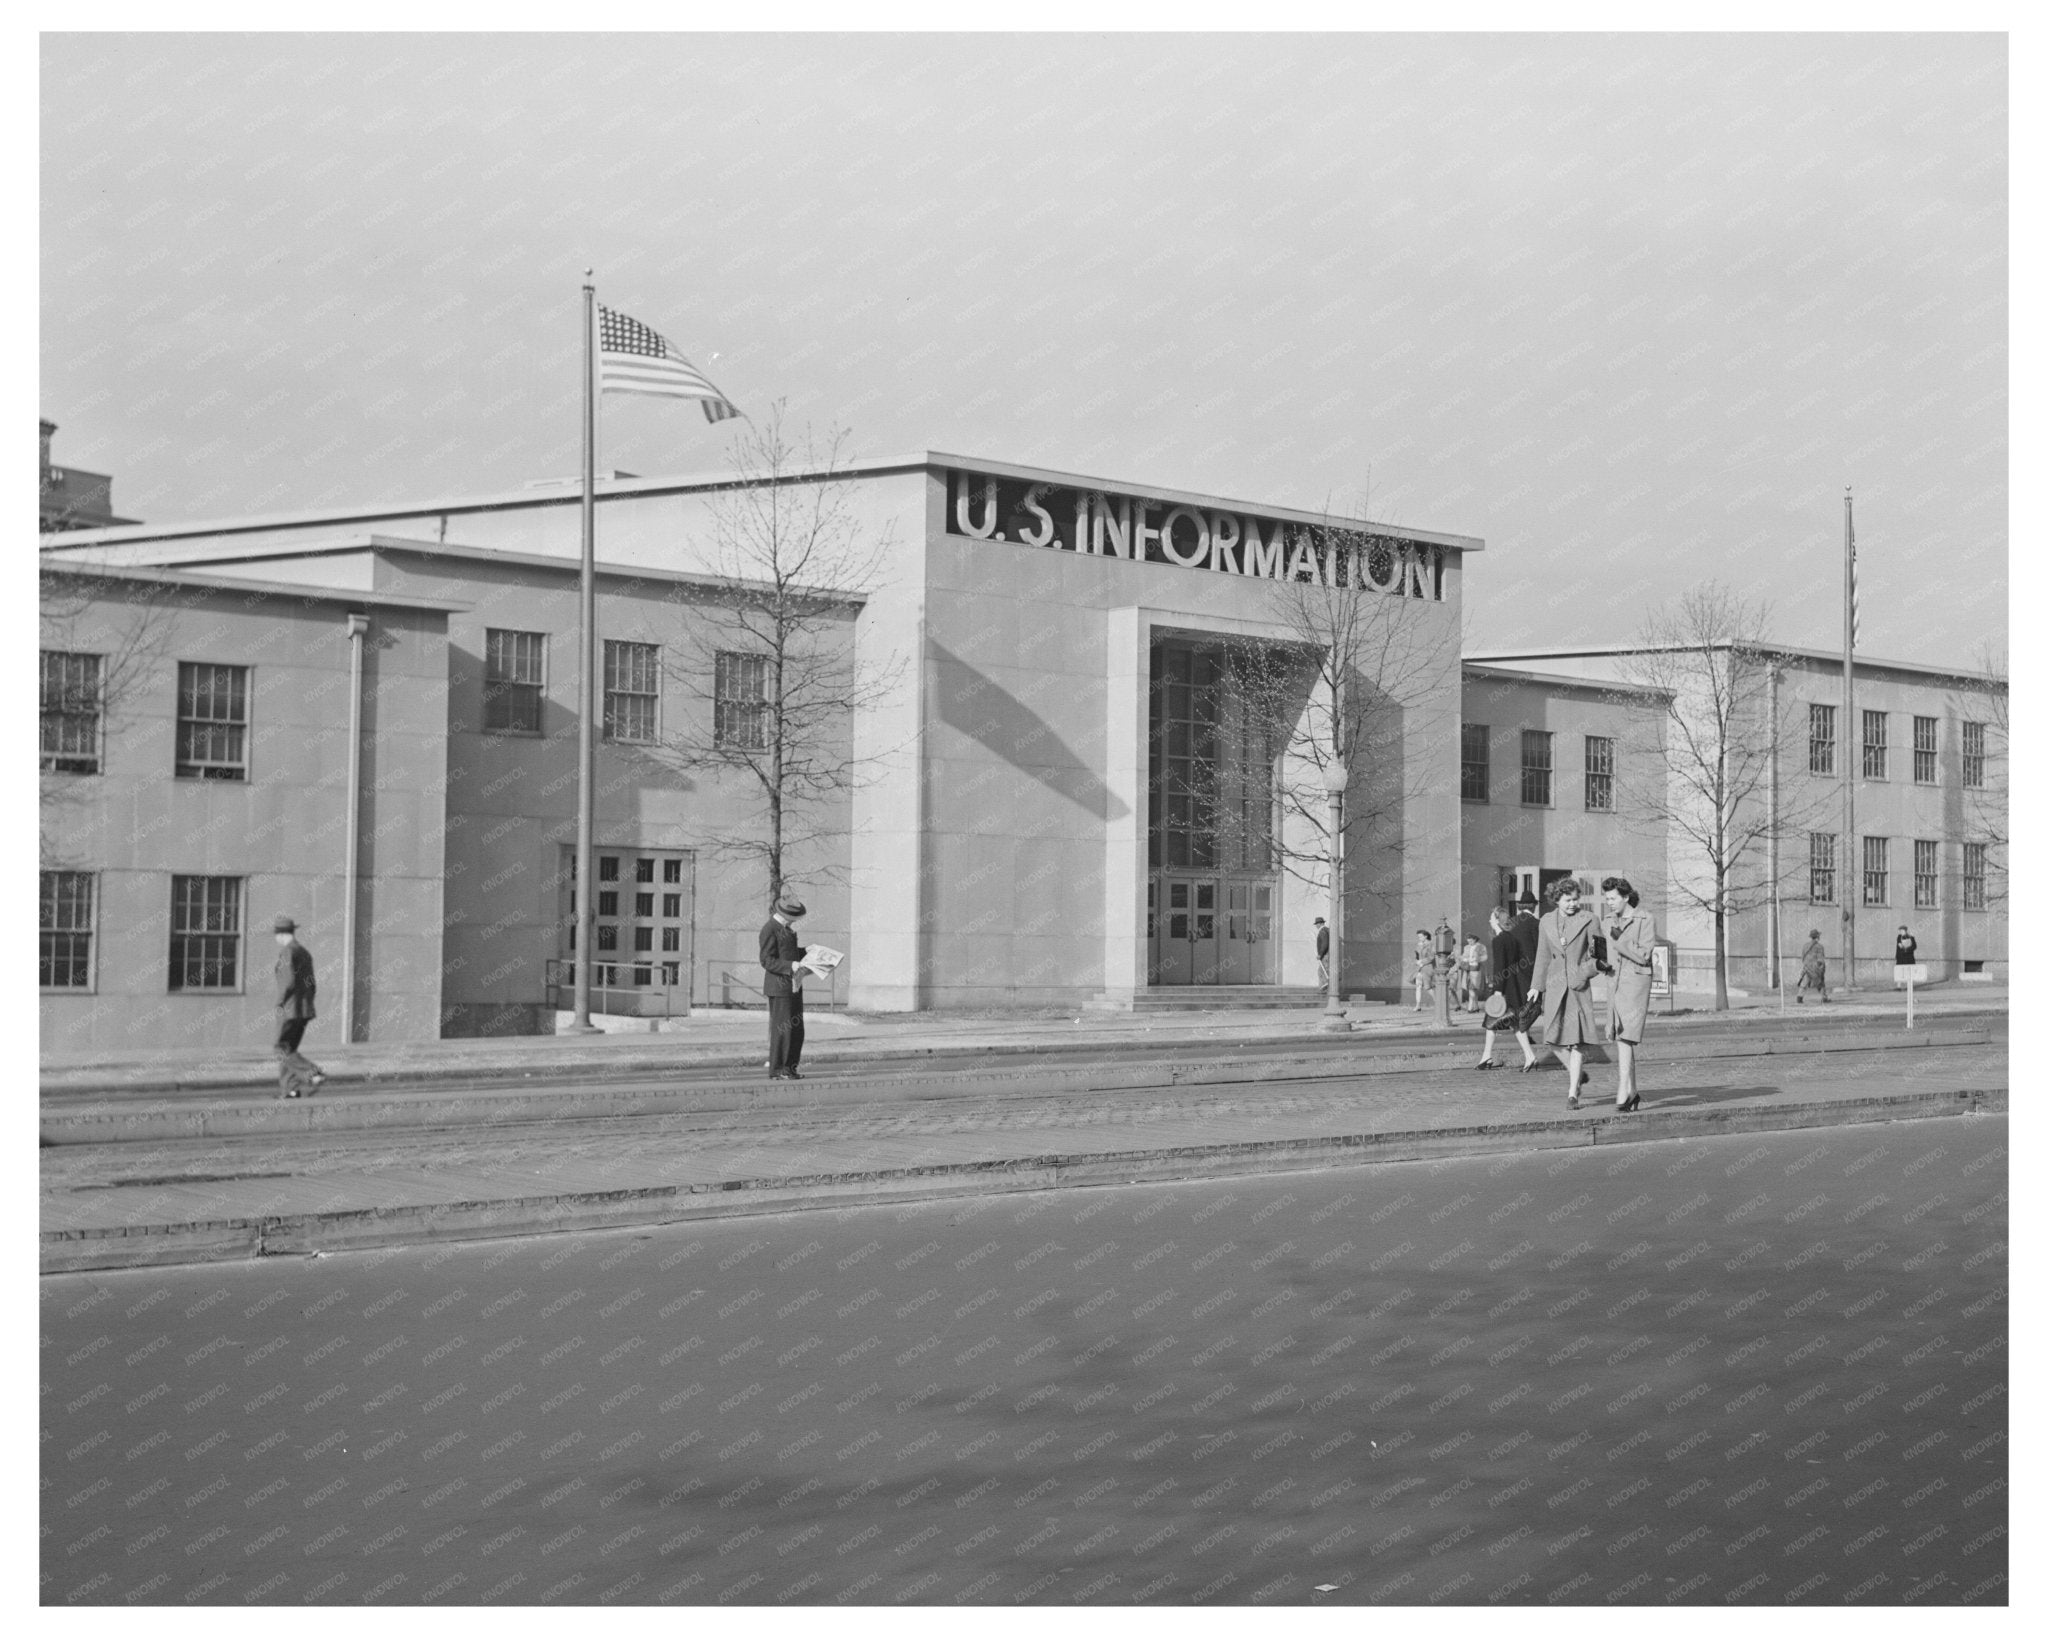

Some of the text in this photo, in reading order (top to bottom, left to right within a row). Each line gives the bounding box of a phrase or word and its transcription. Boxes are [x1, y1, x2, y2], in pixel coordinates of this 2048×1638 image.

[957, 470, 1436, 601] U. S. INFORMATION
